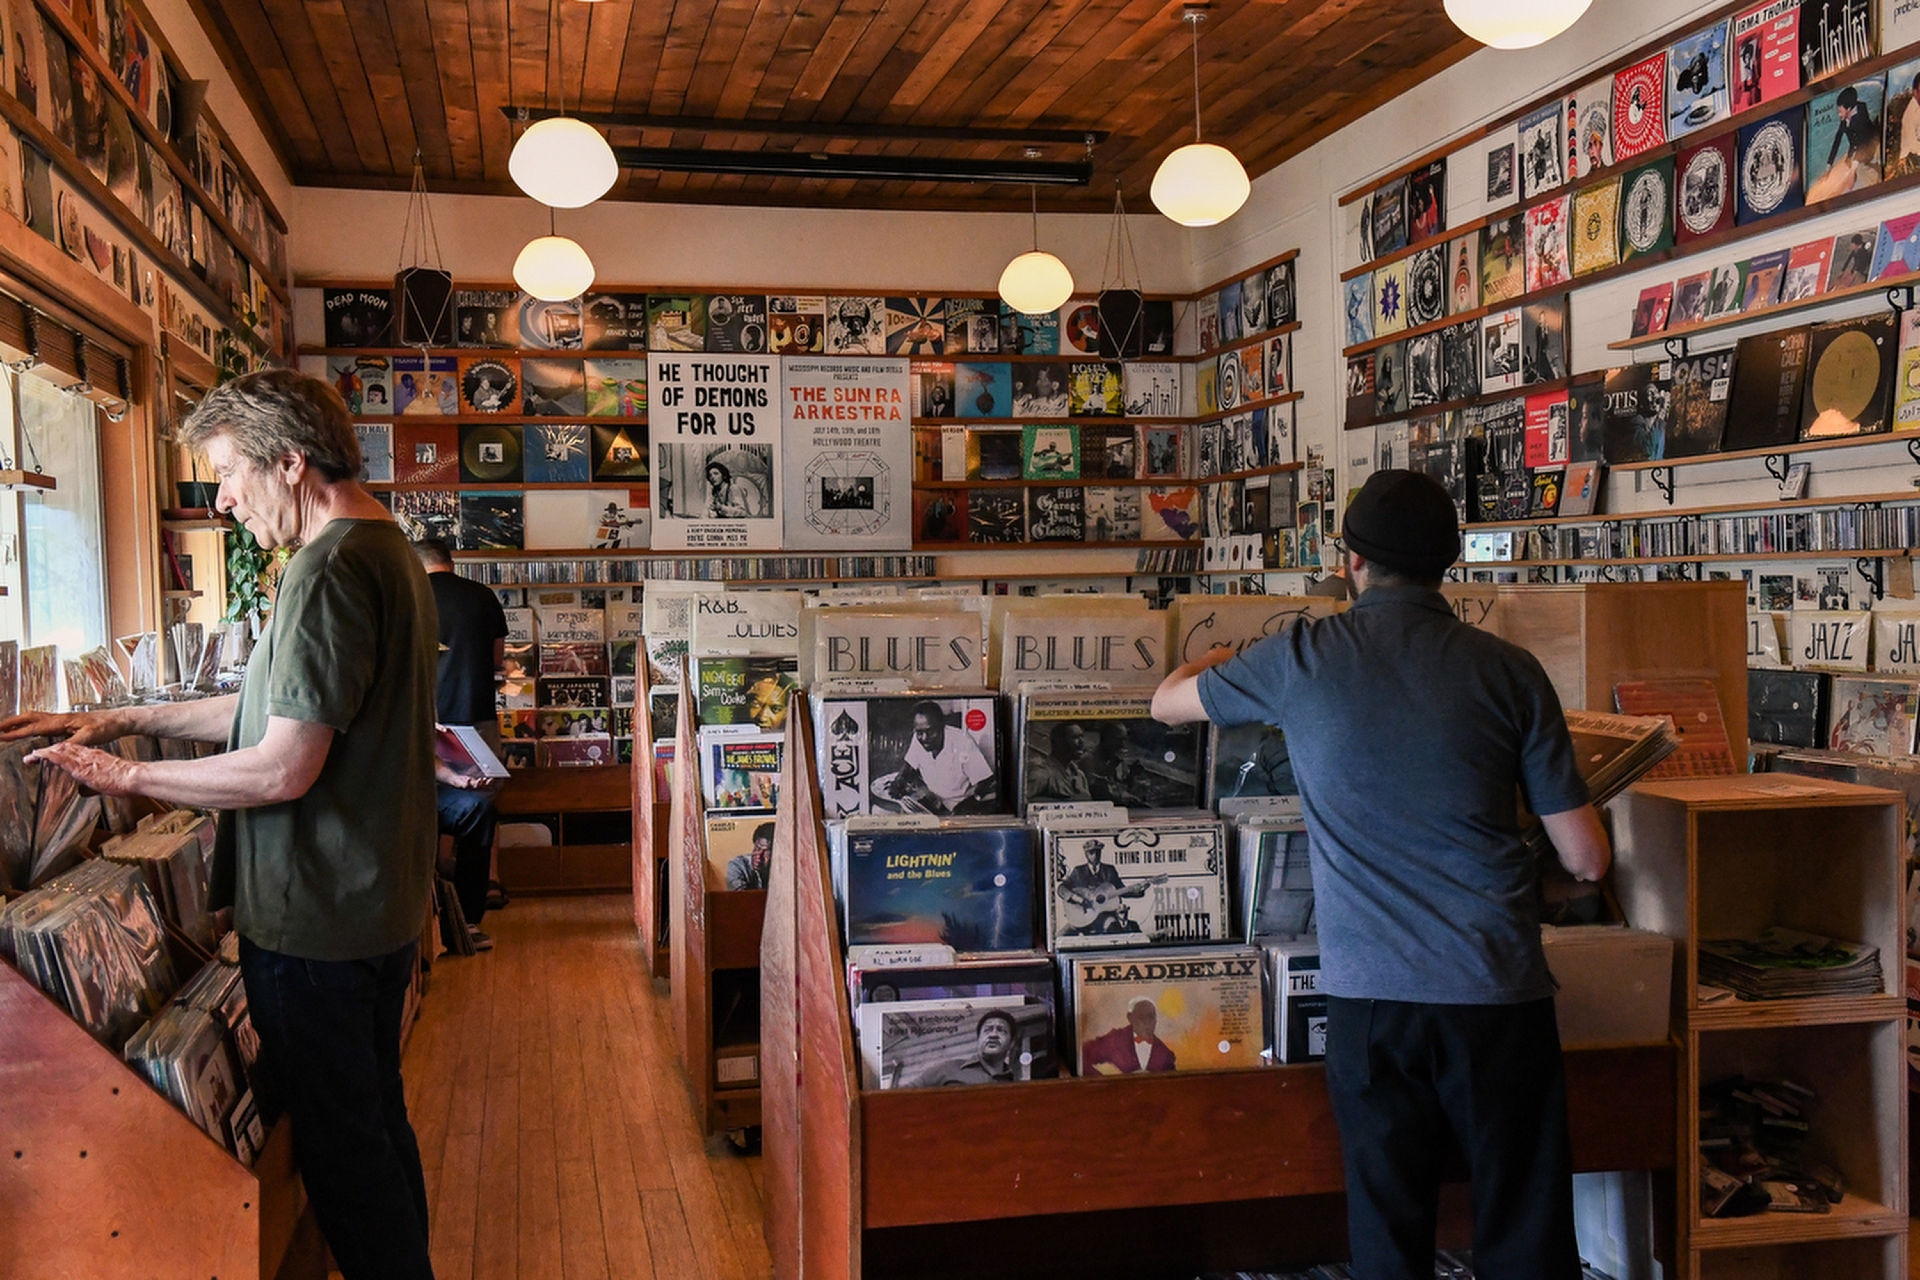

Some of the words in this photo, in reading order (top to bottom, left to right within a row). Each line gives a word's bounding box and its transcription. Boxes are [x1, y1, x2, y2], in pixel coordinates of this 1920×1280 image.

[1737, 15, 1760, 34] IRMA
[326, 293, 354, 311] DEAD
[359, 293, 389, 311] MOON
[659, 363, 681, 382] HE
[691, 363, 770, 383] THOUGHT
[1674, 354, 1734, 385] CASH
[662, 387, 684, 406] OF
[695, 387, 768, 407] DEMONS
[789, 387, 827, 402] THE
[833, 387, 871, 403] SUN
[875, 388, 902, 403] RA
[1602, 390, 1639, 411] OTIS
[793, 404, 902, 421] ARKESTRA
[677, 412, 717, 435] FOR
[728, 412, 755, 436] US
[813, 438, 852, 446] HOLLYWOOD
[854, 438, 881, 447] THEATRE
[1804, 622, 1853, 660] JAZZ
[827, 636, 973, 673] BLUES
[1014, 635, 1157, 672] BLUES
[702, 671, 726, 683] NIGHT
[727, 673, 746, 686] BEAT
[702, 684, 721, 697] Sam
[720, 692, 746, 705] Cooke
[1097, 708, 1143, 716] AROUND
[831, 745, 860, 794] ACE
[886, 852, 957, 868] LIGHTNIN'
[1114, 851, 1140, 864] TRYING
[1143, 850, 1152, 864] TO
[1154, 850, 1166, 863] GET
[1168, 849, 1187, 862] HOME
[887, 870, 905, 880] and
[907, 870, 922, 879] the
[925, 869, 951, 878] Blues
[1083, 960, 1257, 983] LEADBELLY
[1289, 974, 1315, 990] THE
[918, 1012, 965, 1025] Kimbrough
[911, 1025, 959, 1036] Recordings
